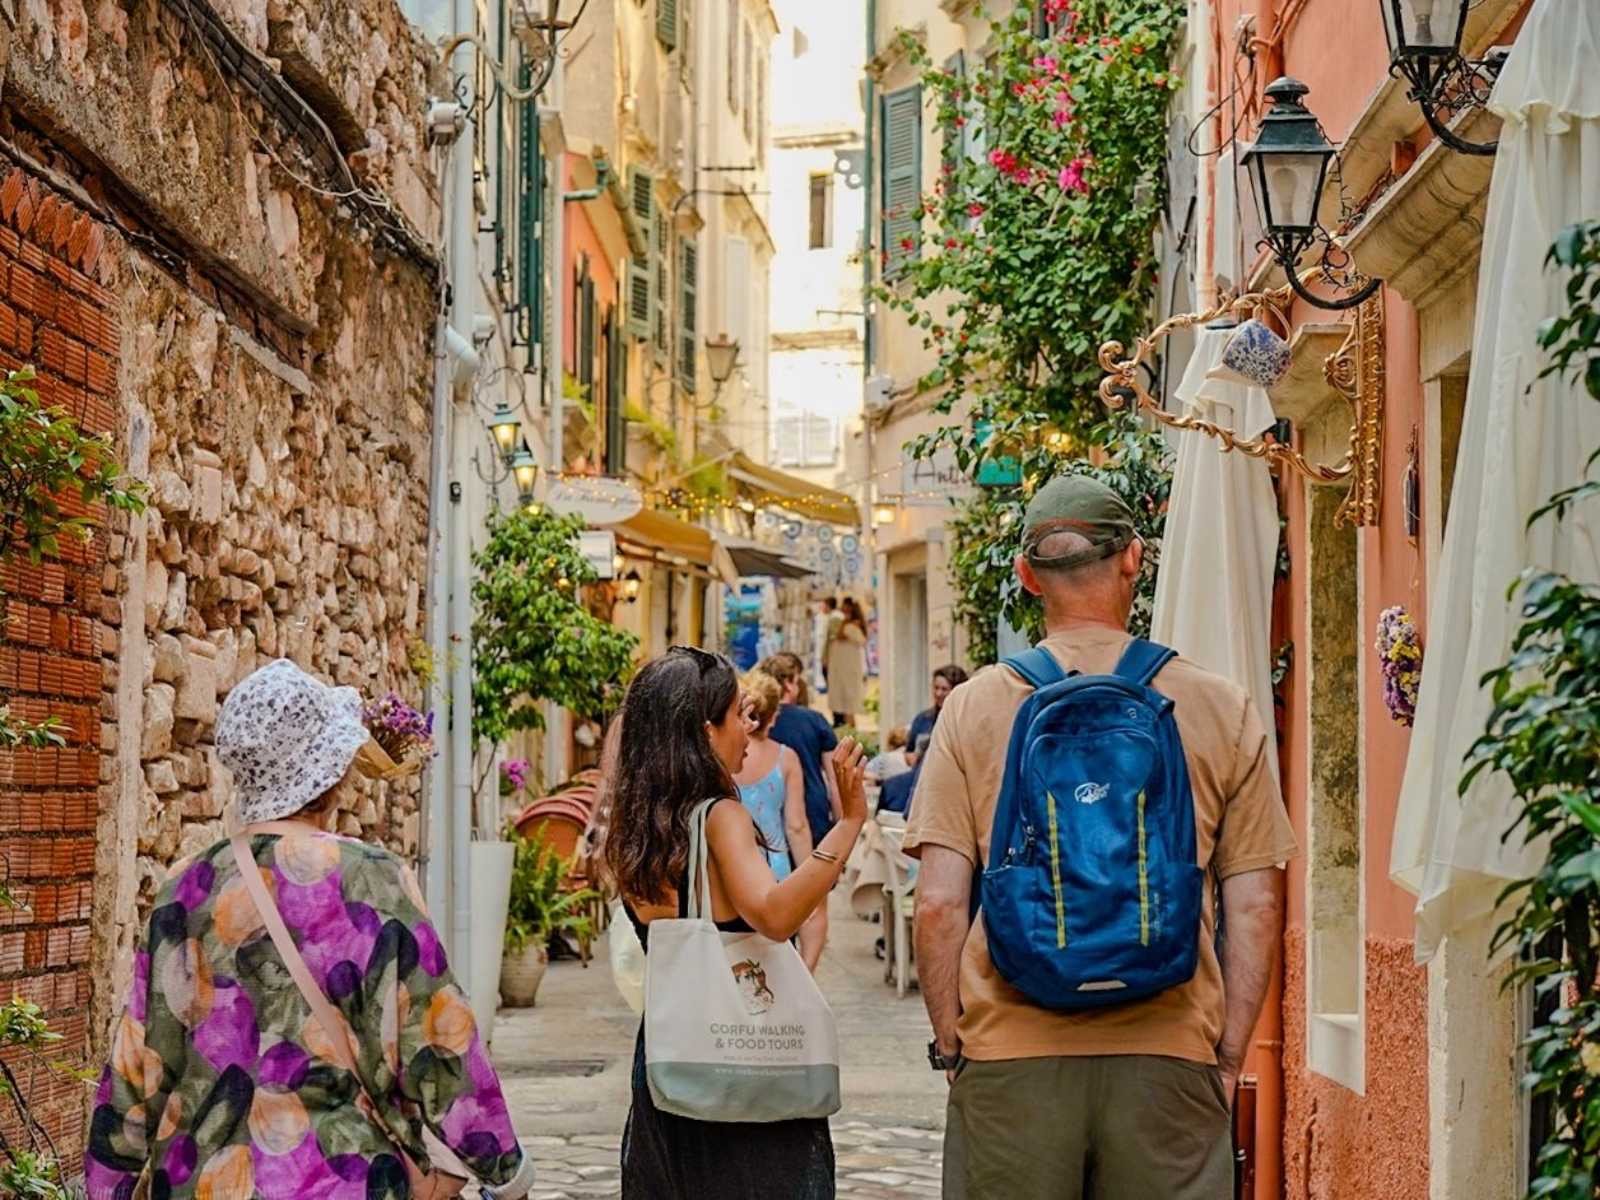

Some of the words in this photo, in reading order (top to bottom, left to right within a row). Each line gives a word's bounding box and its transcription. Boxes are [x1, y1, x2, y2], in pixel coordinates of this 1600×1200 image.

[710, 1023, 756, 1036] CORFU
[758, 1023, 806, 1036] WALKING
[714, 1038, 725, 1049] &
[728, 1039, 766, 1049] FOOD
[767, 1039, 804, 1050] TOURS
